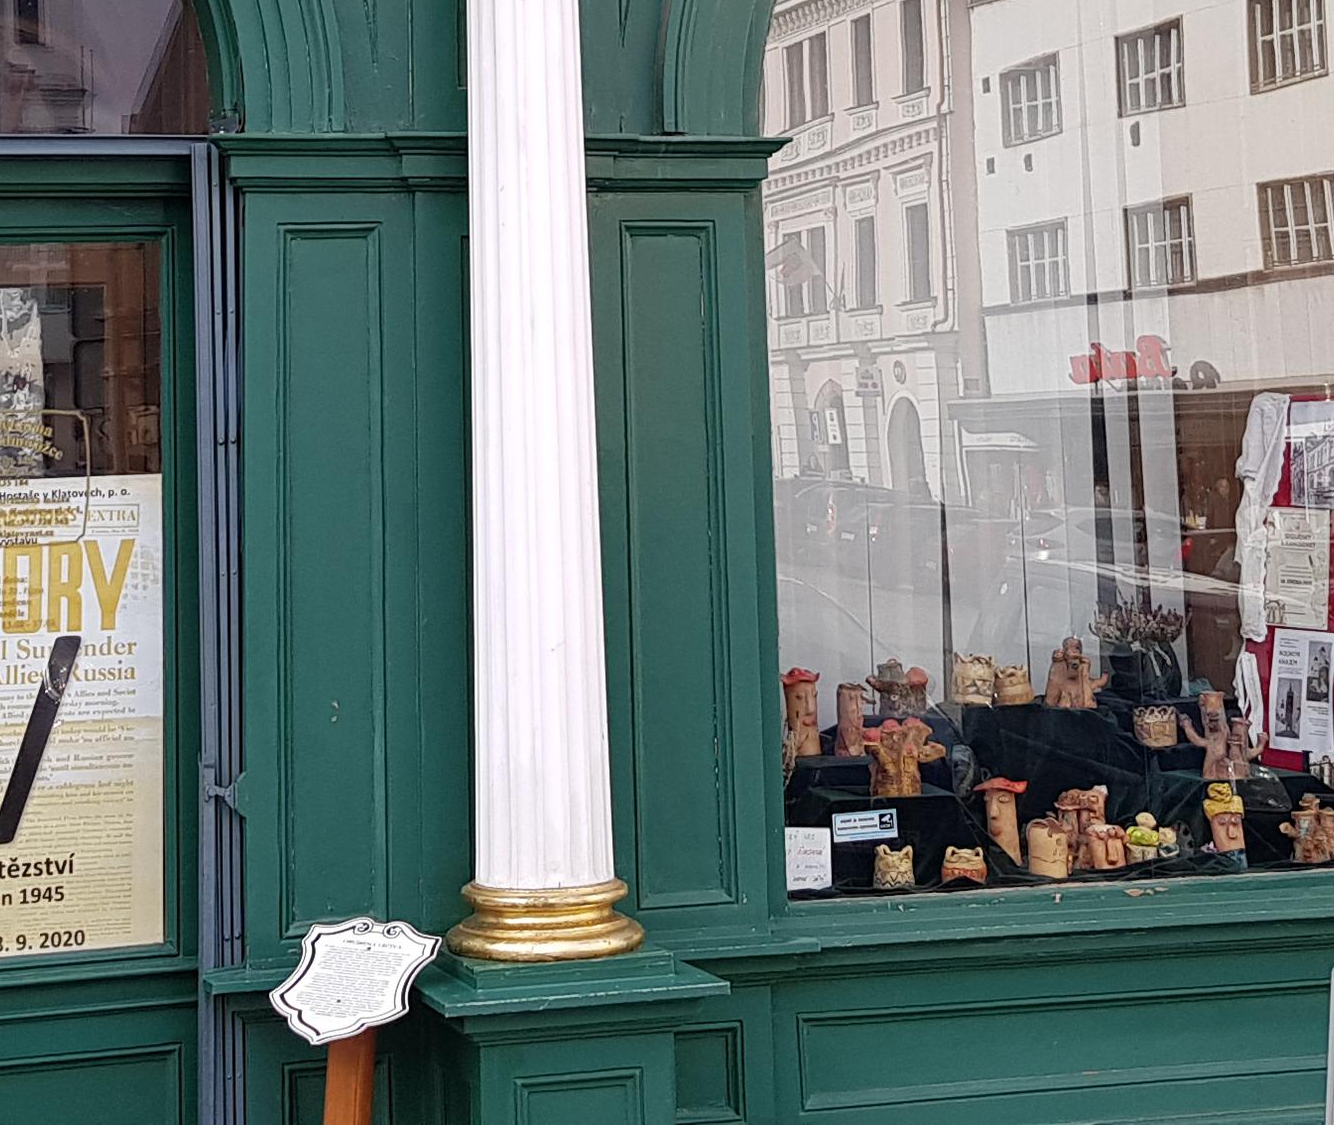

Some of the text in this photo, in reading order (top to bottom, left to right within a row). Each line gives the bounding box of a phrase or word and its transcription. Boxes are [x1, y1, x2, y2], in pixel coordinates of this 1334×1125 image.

[16, 636, 137, 660] Sunder
[19, 885, 65, 905] 1945
[16, 934, 33, 951] 9.
[39, 929, 86, 949] 2020
